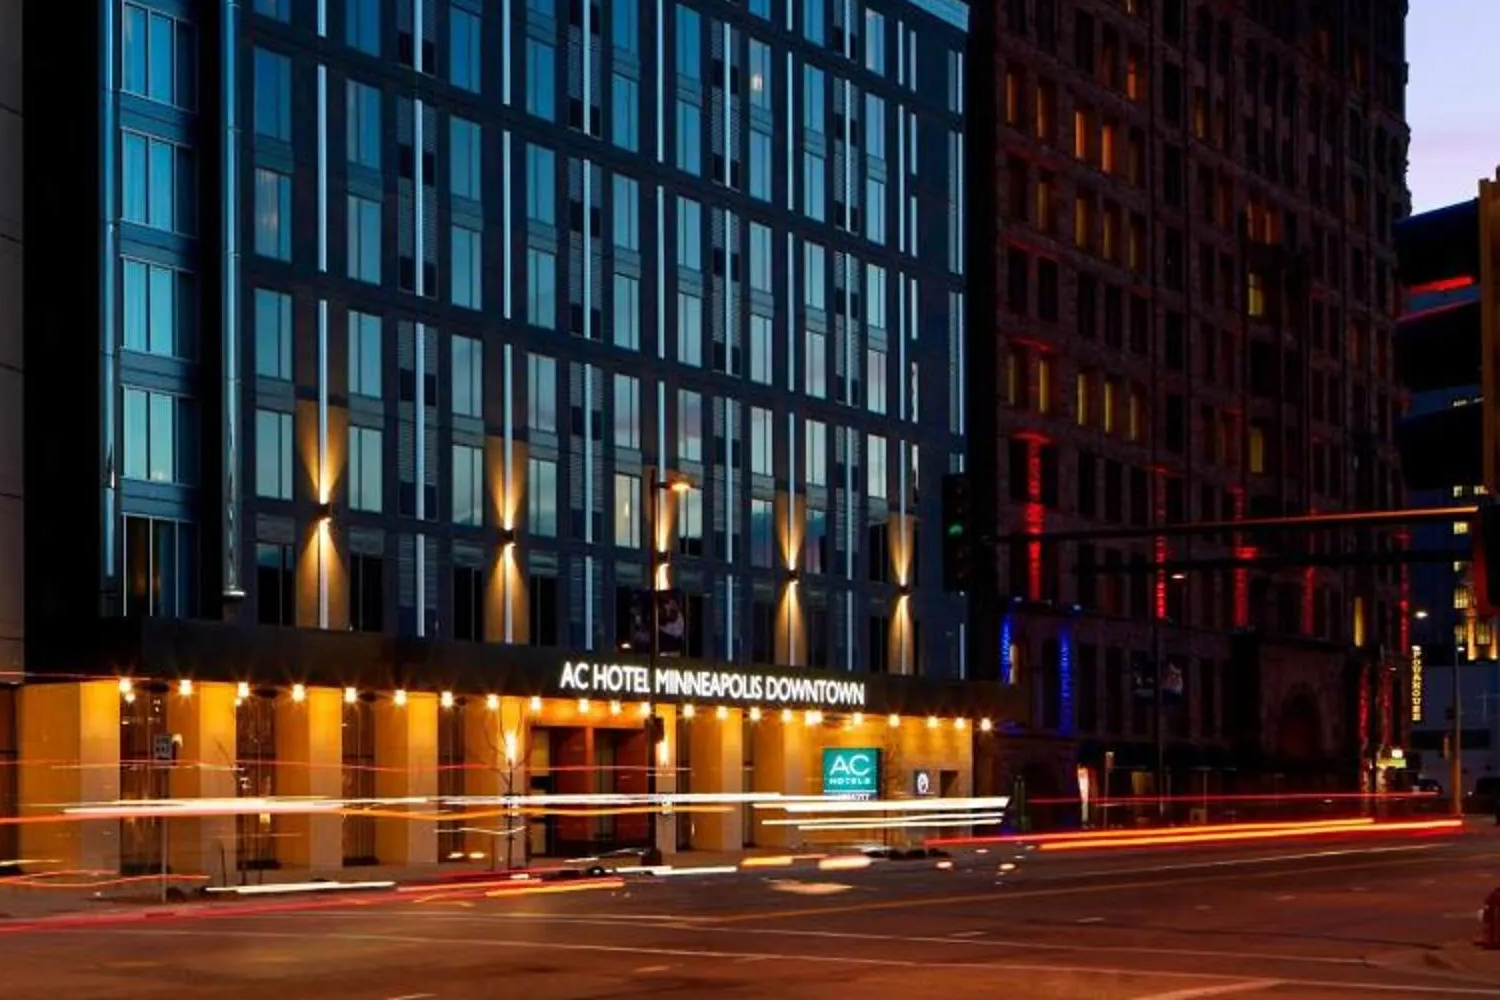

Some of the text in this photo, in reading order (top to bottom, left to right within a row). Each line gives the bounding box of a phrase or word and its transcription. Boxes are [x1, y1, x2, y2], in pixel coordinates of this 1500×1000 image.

[560, 661, 865, 705] AC HOTEL MINNEAPOLIS DOWNTOWN
[829, 754, 870, 776] AC
[829, 777, 871, 785] HOTELS
